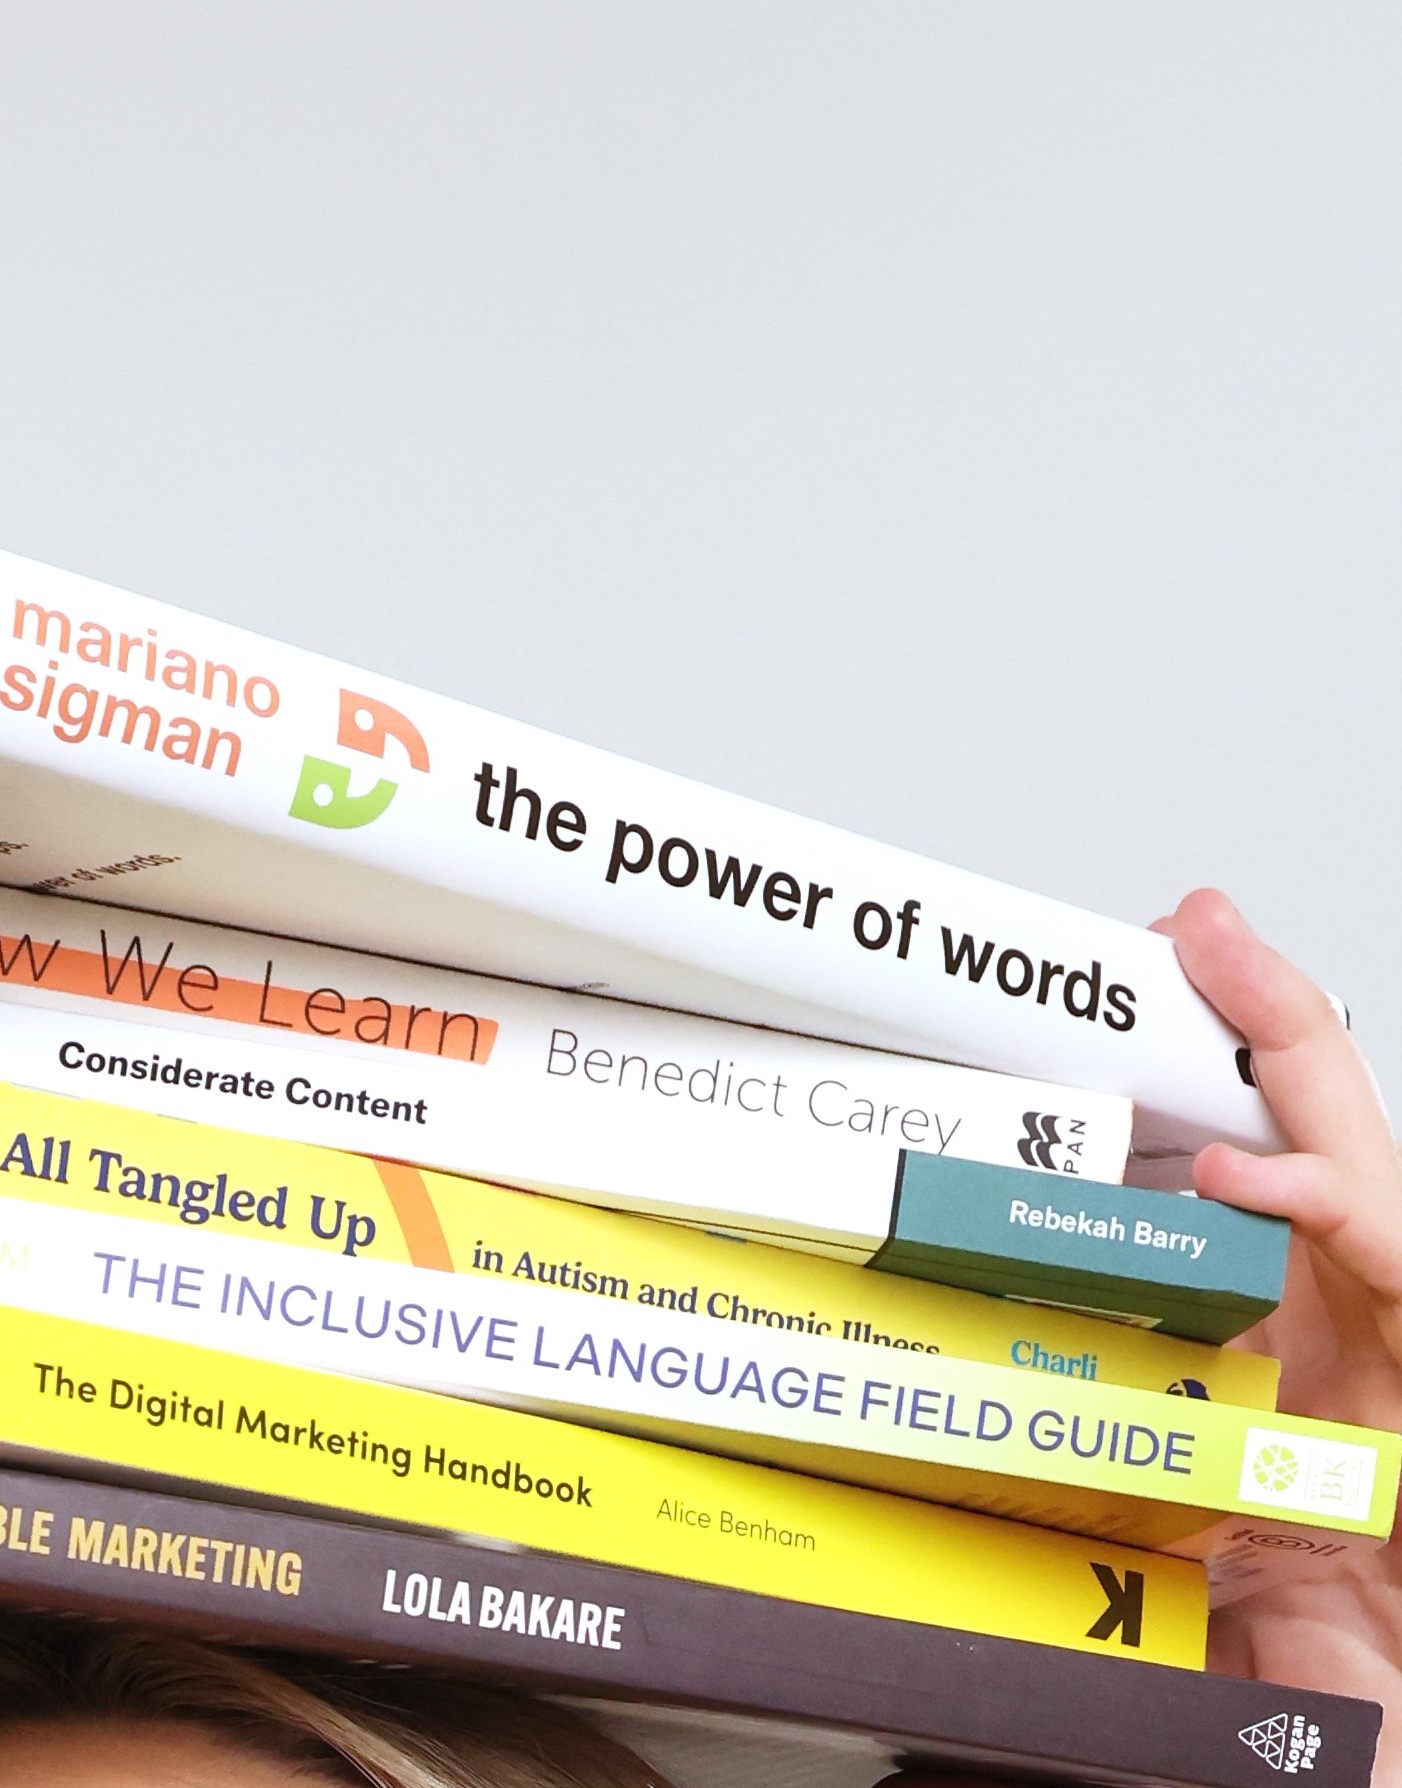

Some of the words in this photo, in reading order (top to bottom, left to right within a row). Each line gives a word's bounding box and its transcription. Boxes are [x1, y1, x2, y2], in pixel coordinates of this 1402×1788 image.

[0, 660, 242, 778] sigman
[12, 598, 280, 718] mariano
[473, 762, 587, 852] the
[605, 819, 833, 930] power
[852, 898, 920, 960] of
[939, 925, 1136, 1032] words
[99, 928, 219, 1012] We
[257, 960, 481, 1062] Learn
[547, 1028, 789, 1118] Benedict
[808, 1080, 962, 1156] Carey
[57, 1040, 275, 1100] Considerate
[285, 1076, 429, 1125] Content
[1009, 1200, 1127, 1242] Rebekah
[1133, 1220, 1207, 1259] Barry
[1063, 1119, 1087, 1175] PAN
[0, 1132, 71, 1184] All
[89, 1148, 288, 1230] Tangled
[310, 1194, 376, 1257] Up
[472, 1239, 504, 1274] in
[511, 1251, 628, 1300] Autism
[637, 1283, 698, 1315] and
[706, 1291, 832, 1336] Chronic
[1011, 1339, 1098, 1381] Charli
[93, 1251, 205, 1309] THE
[220, 1273, 519, 1361] INCLUSIVE
[532, 1325, 845, 1416] LANGUAGE
[859, 1380, 1014, 1442] FIELD
[1028, 1410, 1196, 1475] GUIDE
[34, 1362, 97, 1402] The
[109, 1378, 224, 1427] Digital
[234, 1405, 411, 1478] Marketing
[423, 1444, 593, 1508] Handbook
[656, 1498, 711, 1529] Alice
[719, 1511, 816, 1551] Benham
[1319, 1457, 1347, 1502] BK
[68, 1517, 303, 1597] MARKETING
[383, 1568, 472, 1626] LOLA
[478, 1581, 626, 1650] BAKARE
[1284, 1715, 1306, 1774] Kogan
[1300, 1724, 1321, 1770] Page
